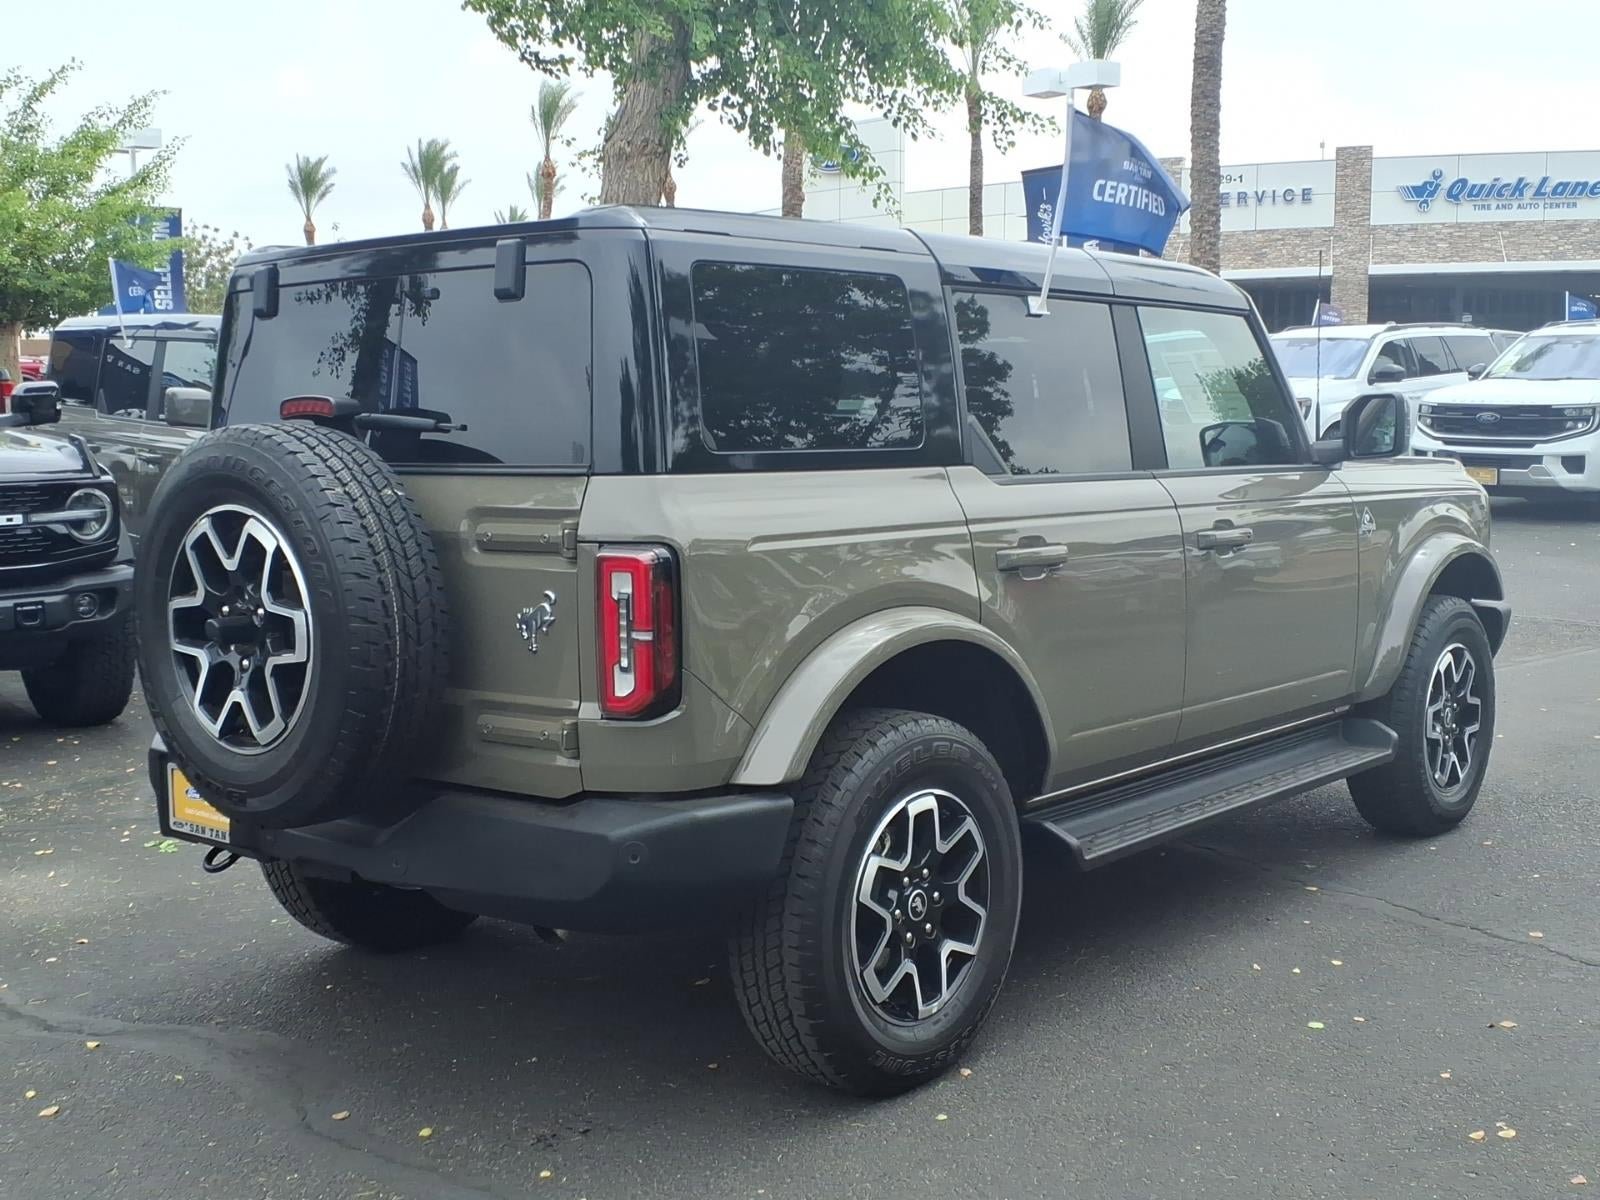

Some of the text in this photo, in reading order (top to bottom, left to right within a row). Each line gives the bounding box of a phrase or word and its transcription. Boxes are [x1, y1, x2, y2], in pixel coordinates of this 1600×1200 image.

[1092, 179, 1166, 217] CERTIFIED
[1220, 188, 1312, 206] ERVICE
[1446, 175, 1600, 203] Quick Lane
[1495, 203, 1513, 211] AND
[1543, 202, 1578, 210] CENTER
[152, 222, 173, 310] SELCON
[189, 823, 206, 836] SAN
[208, 827, 227, 841] TAN
